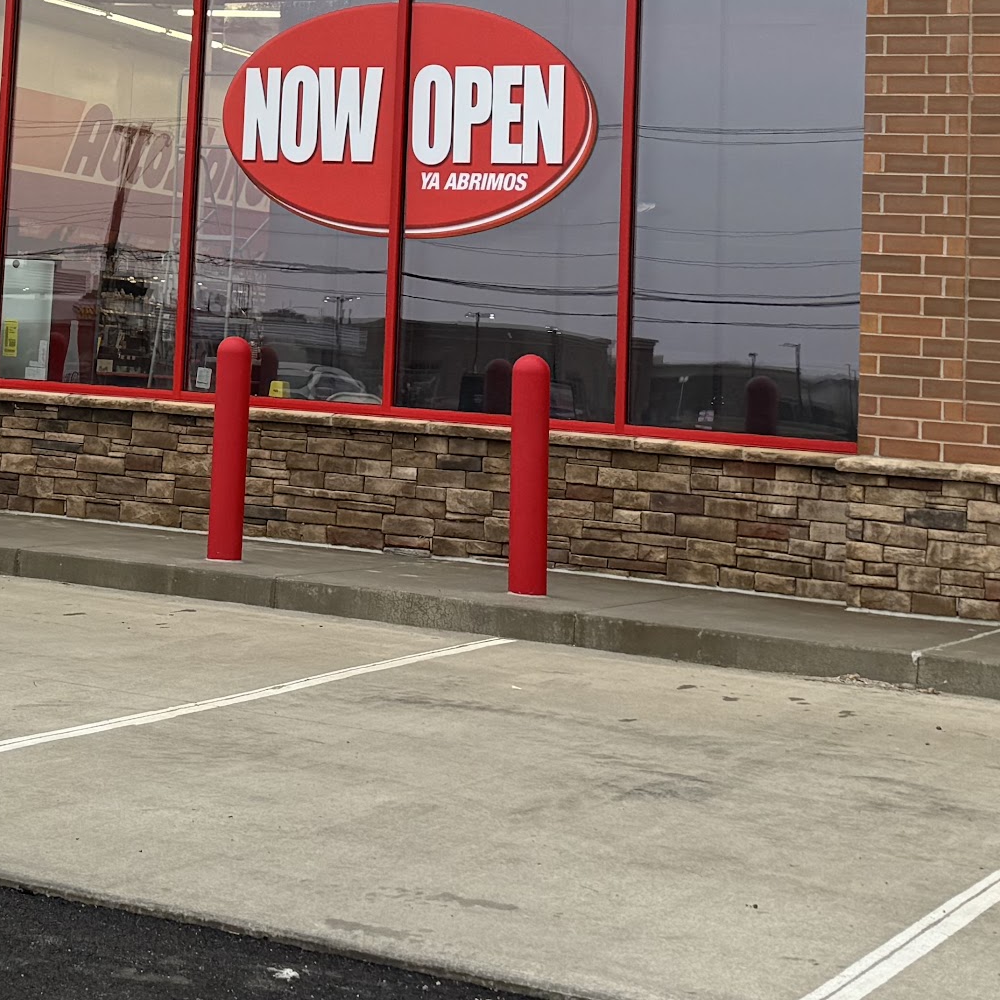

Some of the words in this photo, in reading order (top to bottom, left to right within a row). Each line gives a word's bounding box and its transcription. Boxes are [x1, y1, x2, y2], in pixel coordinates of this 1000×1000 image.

[242, 65, 384, 162] NOW
[411, 63, 565, 165] OPEN
[421, 172, 440, 190] YA
[444, 172, 529, 191] ABRIMOS
